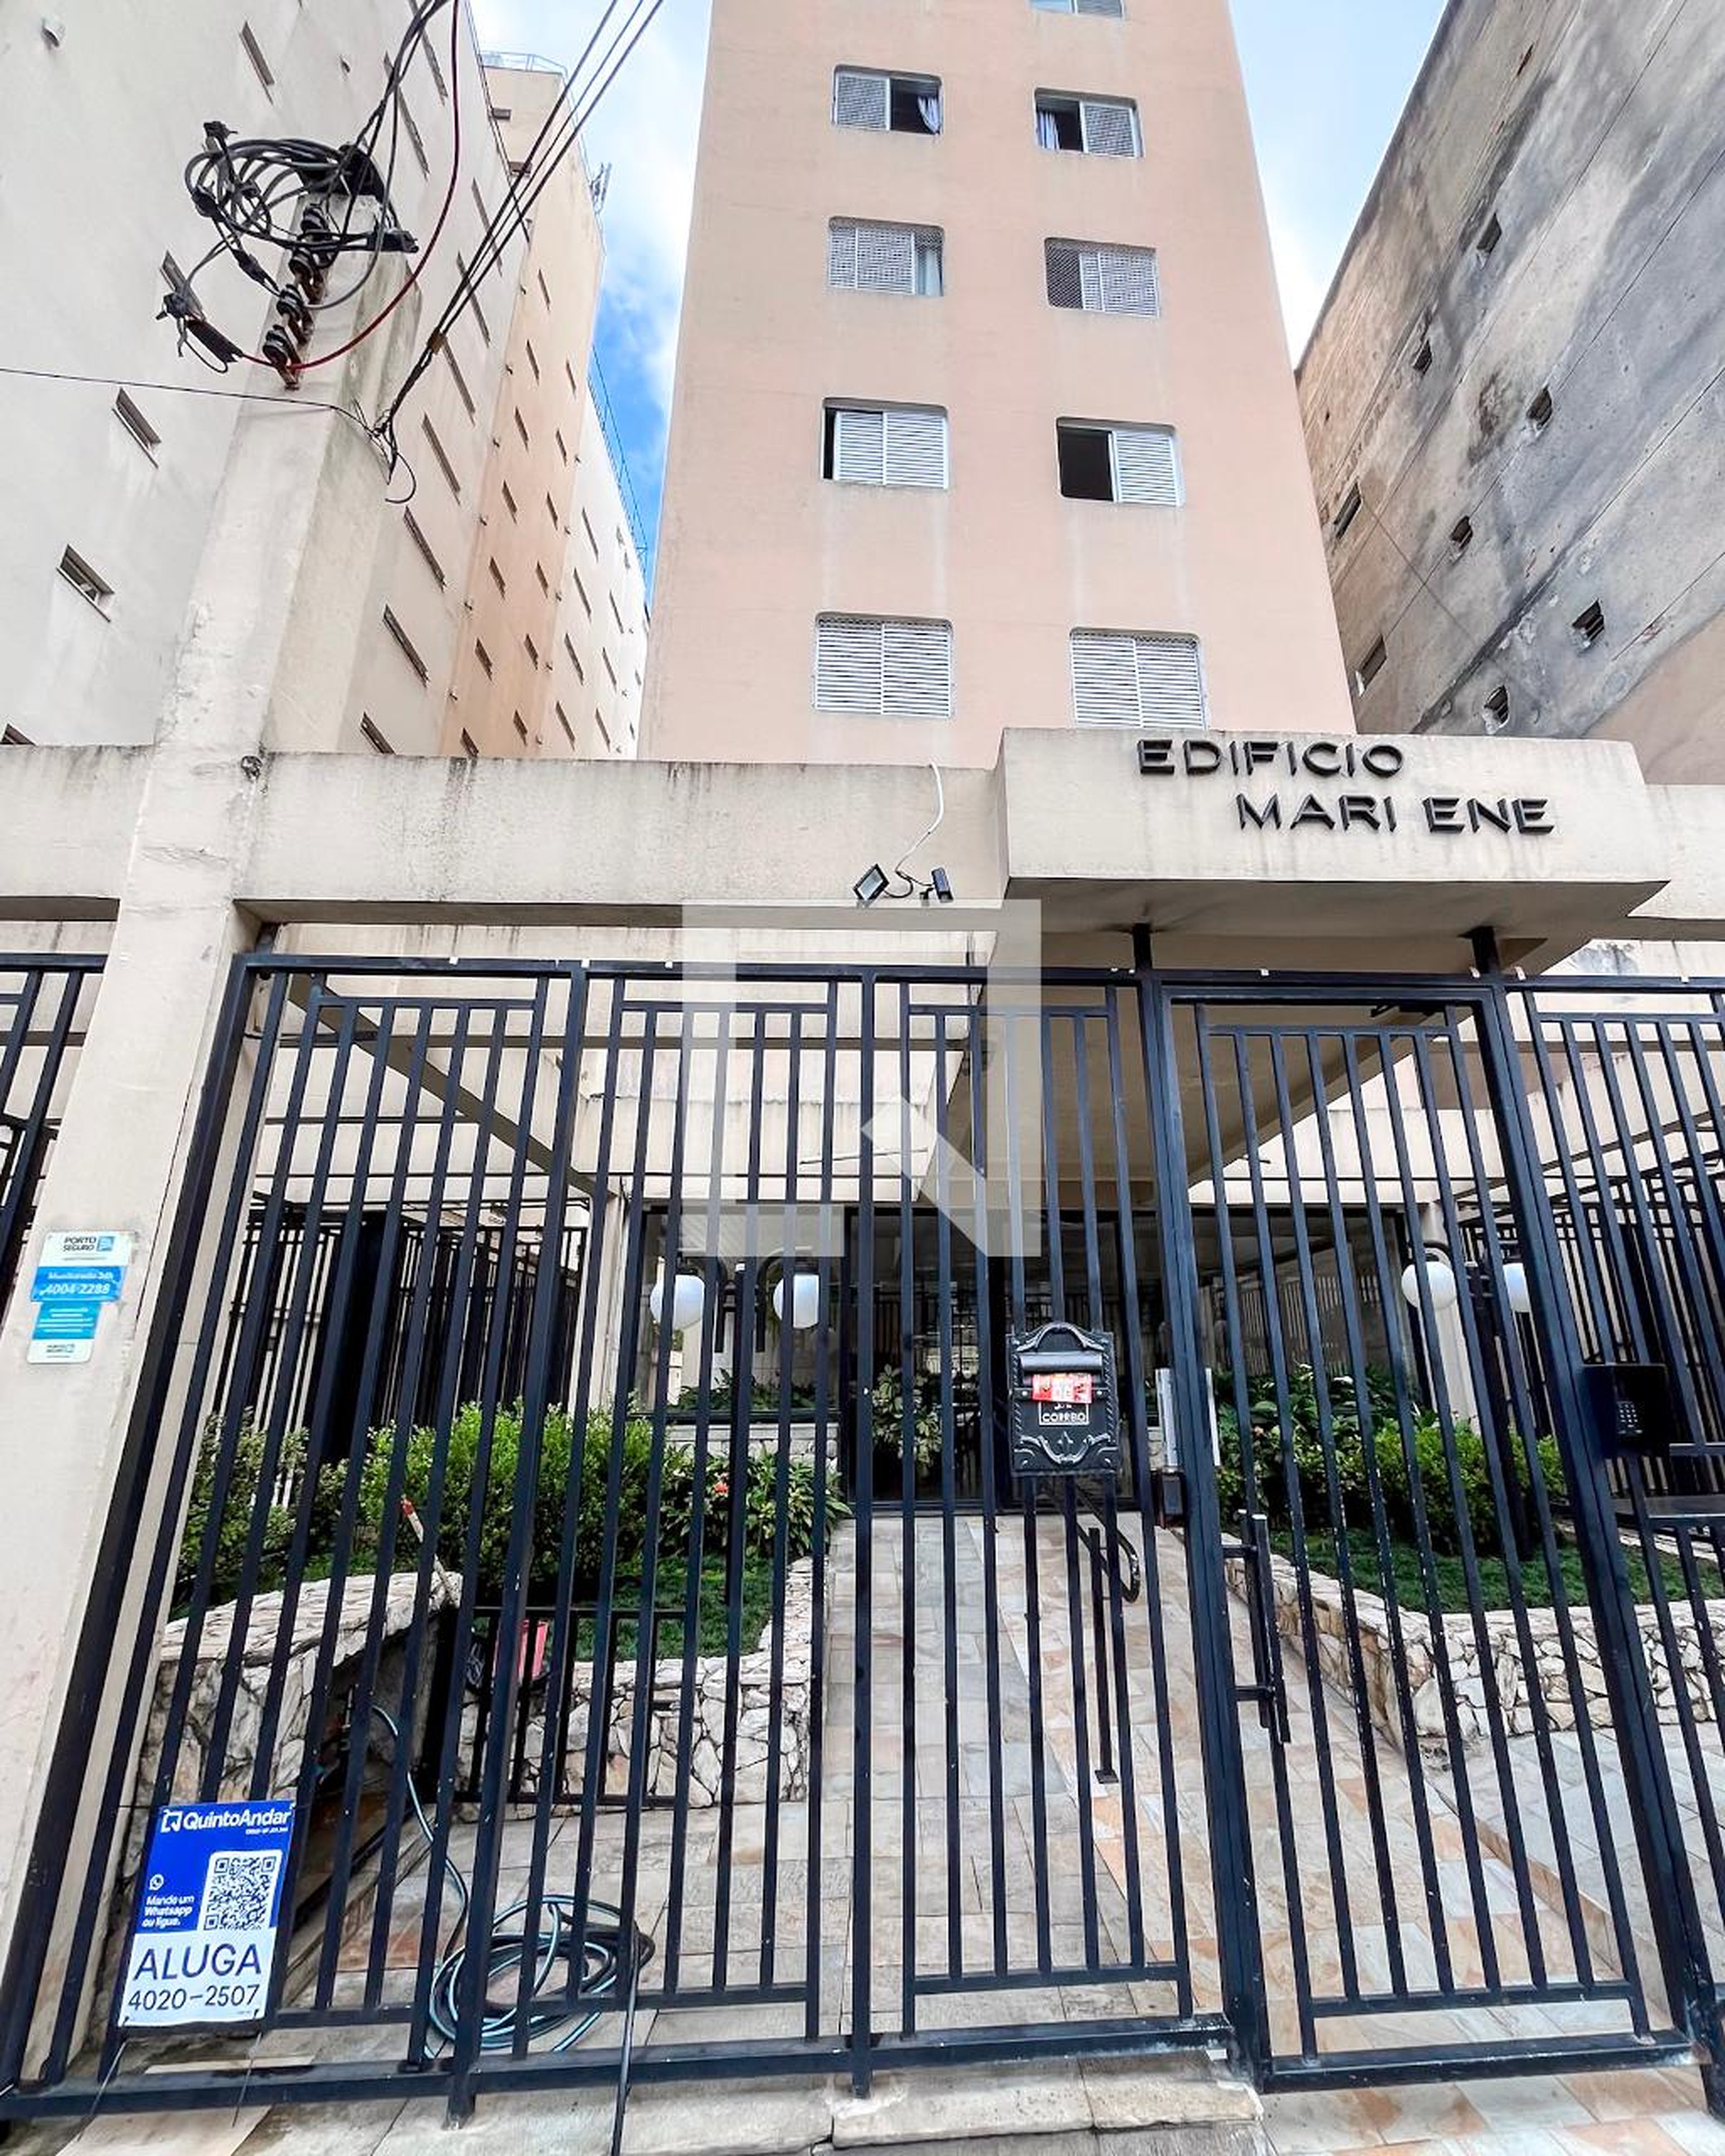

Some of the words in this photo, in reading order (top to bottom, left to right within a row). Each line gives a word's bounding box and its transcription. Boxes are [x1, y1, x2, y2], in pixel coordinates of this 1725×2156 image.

[1137, 739, 1403, 778] EDIFICIO
[1235, 793, 1397, 832] MARI
[1422, 796, 1554, 834] ENE
[183, 1808, 292, 1830] QuintoAndar
[146, 1895, 178, 1905] Mande
[179, 1895, 195, 1905] um
[142, 1918, 155, 1927] ou
[133, 1943, 262, 1981] ALUGA
[128, 1984, 261, 2011] 4020-2507
